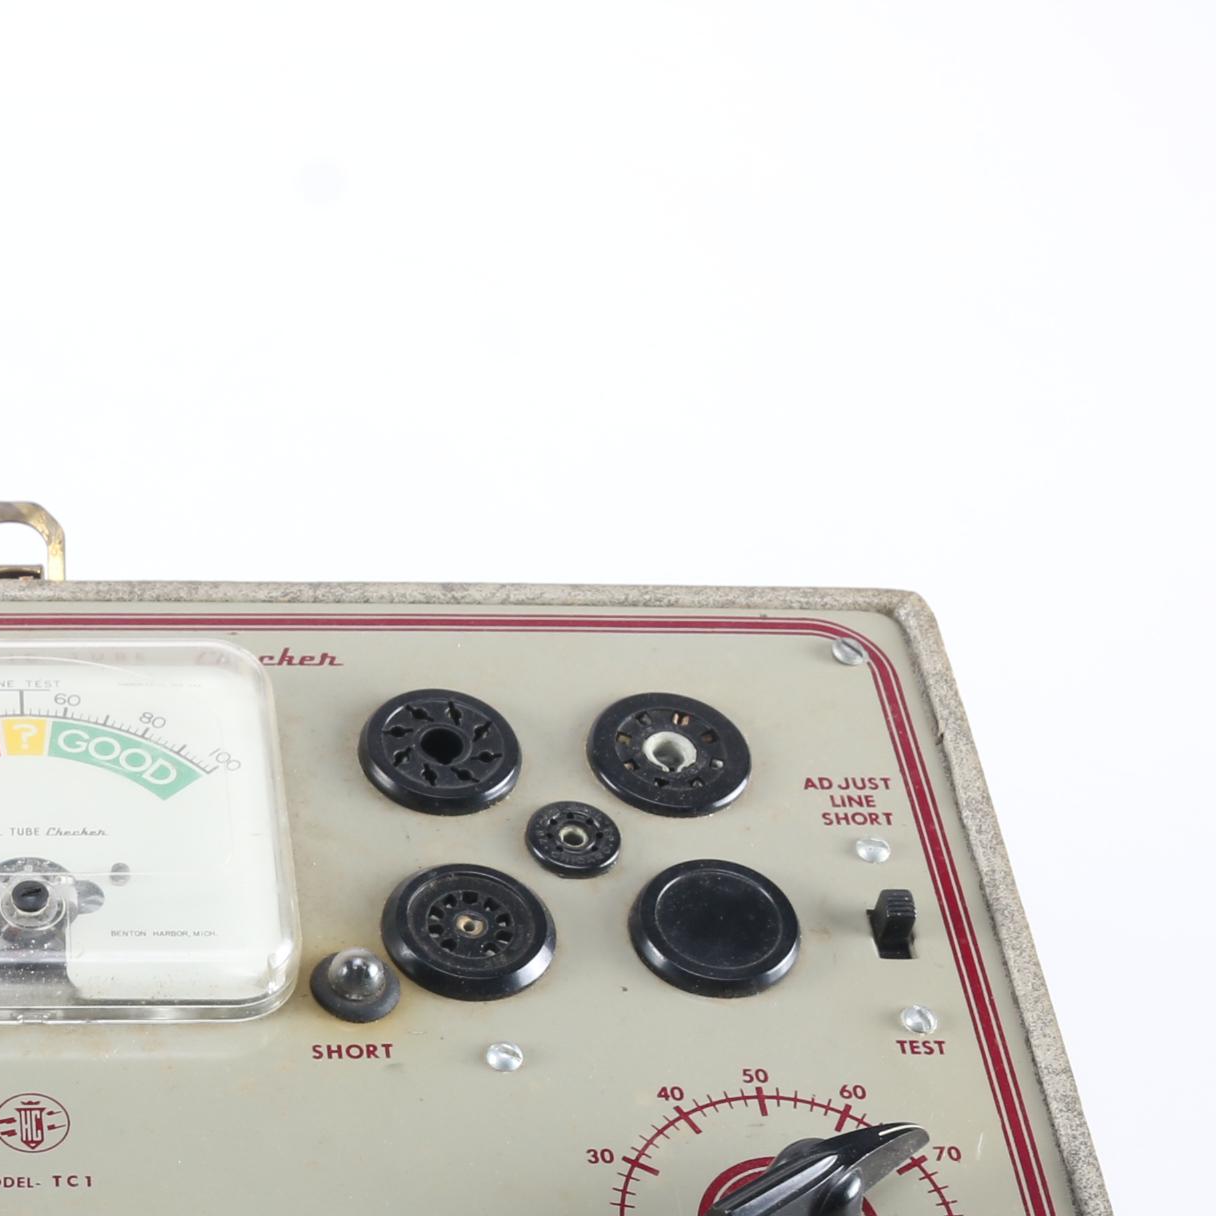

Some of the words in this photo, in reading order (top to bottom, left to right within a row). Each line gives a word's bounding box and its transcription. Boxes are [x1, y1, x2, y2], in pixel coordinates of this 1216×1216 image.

[25, 679, 61, 689] TEST
[53, 692, 82, 707] 60
[138, 711, 167, 729] 80
[13, 725, 37, 750] ?
[58, 730, 177, 785] GOOD
[208, 748, 242, 773] 100
[804, 777, 890, 790] ADJUST
[830, 795, 875, 807] LINE
[822, 812, 892, 825] SHORT
[9, 826, 41, 837] TUBE
[45, 826, 110, 837] Checker
[313, 1043, 392, 1059] SHORT
[896, 1040, 945, 1055] TEST
[743, 1069, 768, 1083] 50
[657, 1085, 685, 1101] 40
[839, 1083, 867, 1101] 60
[587, 1149, 614, 1164] 30
[934, 1145, 963, 1163] 70
